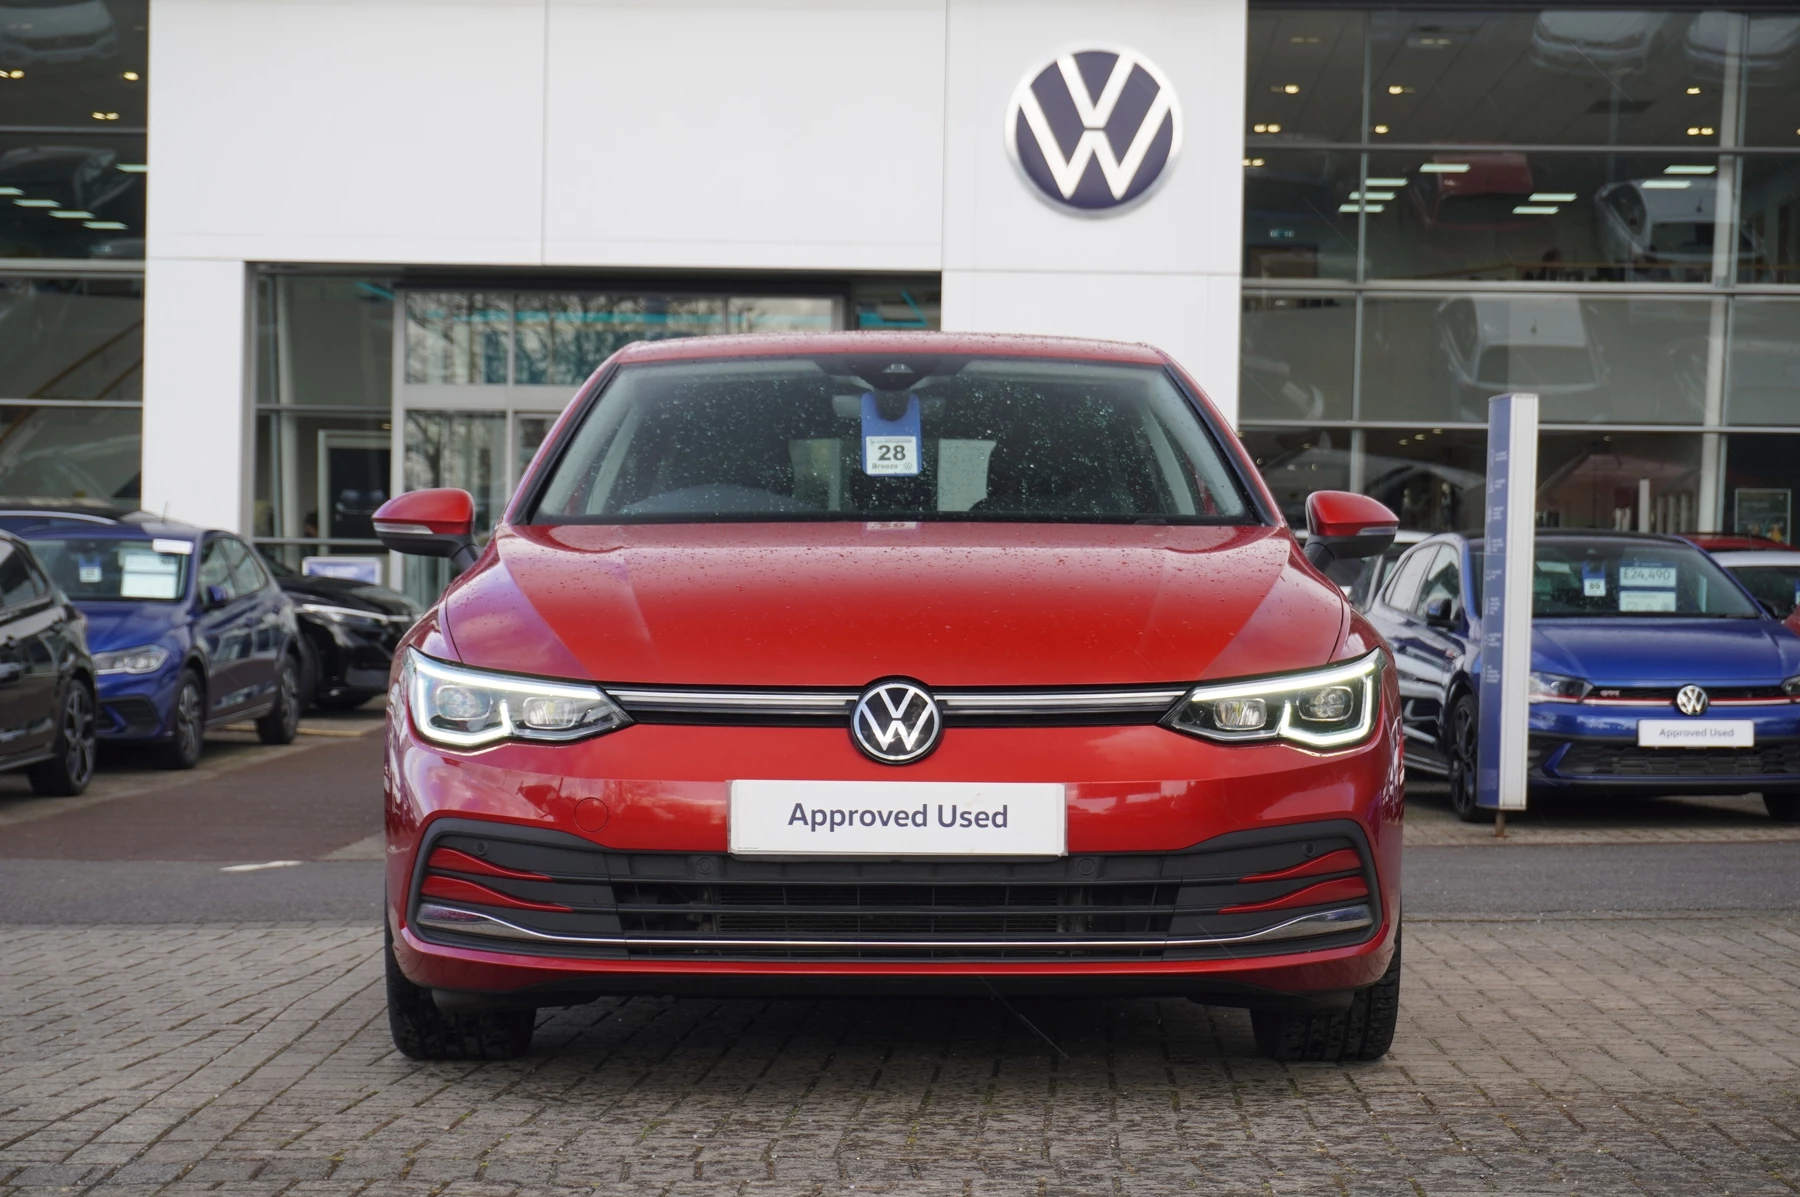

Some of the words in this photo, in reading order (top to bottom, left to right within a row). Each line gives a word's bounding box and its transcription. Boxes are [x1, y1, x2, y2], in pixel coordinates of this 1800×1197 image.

[877, 444, 906, 461] 28
[871, 462, 899, 470] Breeze
[1623, 567, 1671, 581] £24,490
[1659, 728, 1707, 738] Approved
[1710, 728, 1735, 737] Used
[788, 802, 928, 832] Approved
[937, 804, 1009, 829] Used
